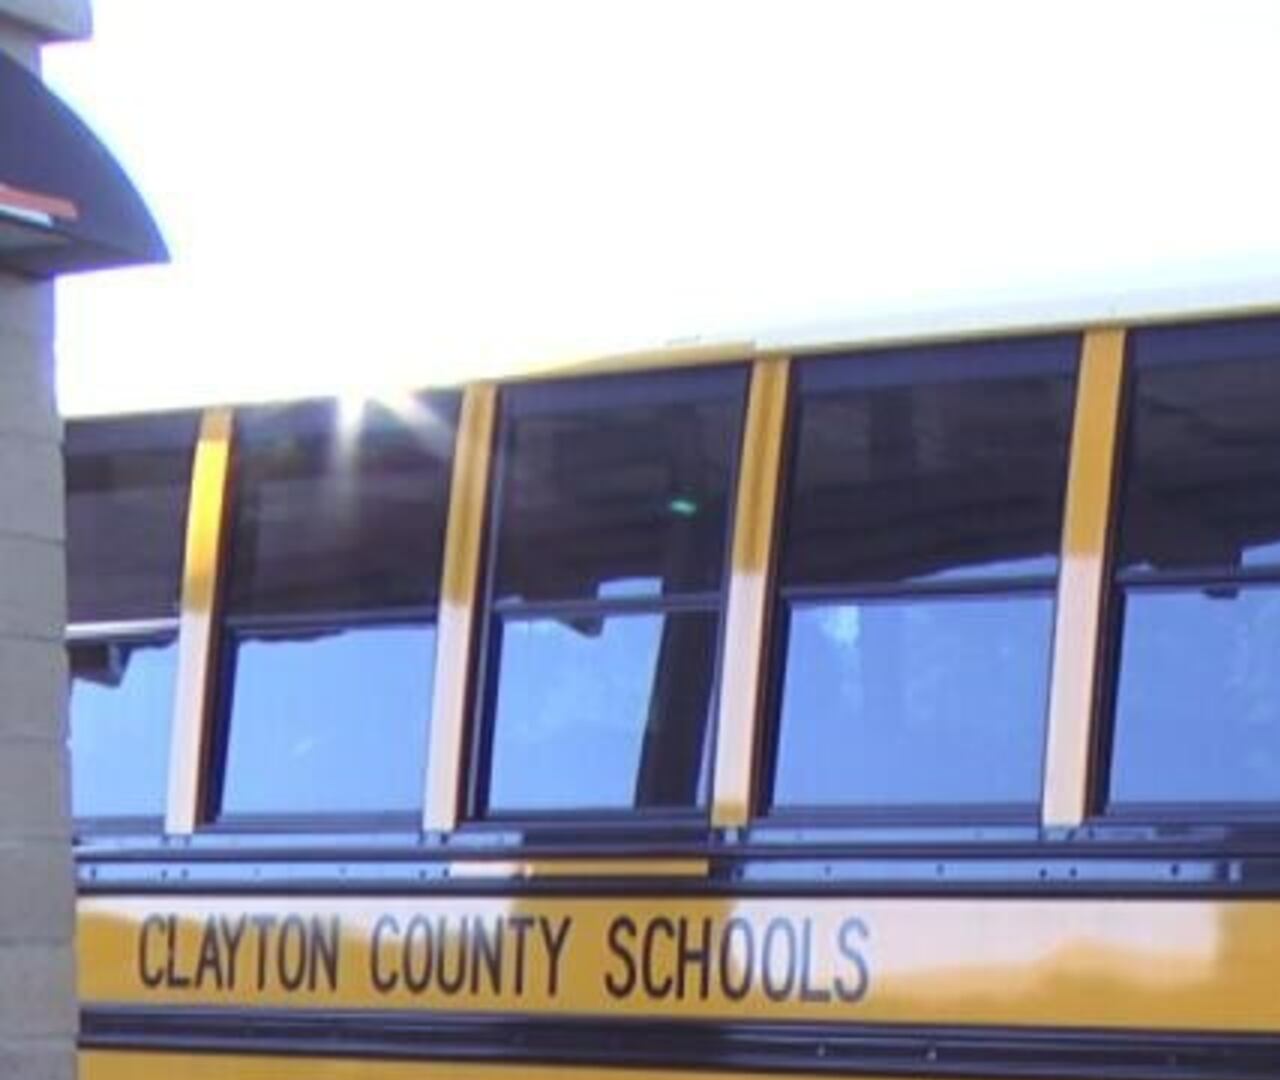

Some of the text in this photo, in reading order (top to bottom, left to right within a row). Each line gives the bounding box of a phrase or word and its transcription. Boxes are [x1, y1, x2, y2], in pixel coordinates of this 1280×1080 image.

[137, 914, 872, 1003] CLAYTON COUNTY SCHOOLS
